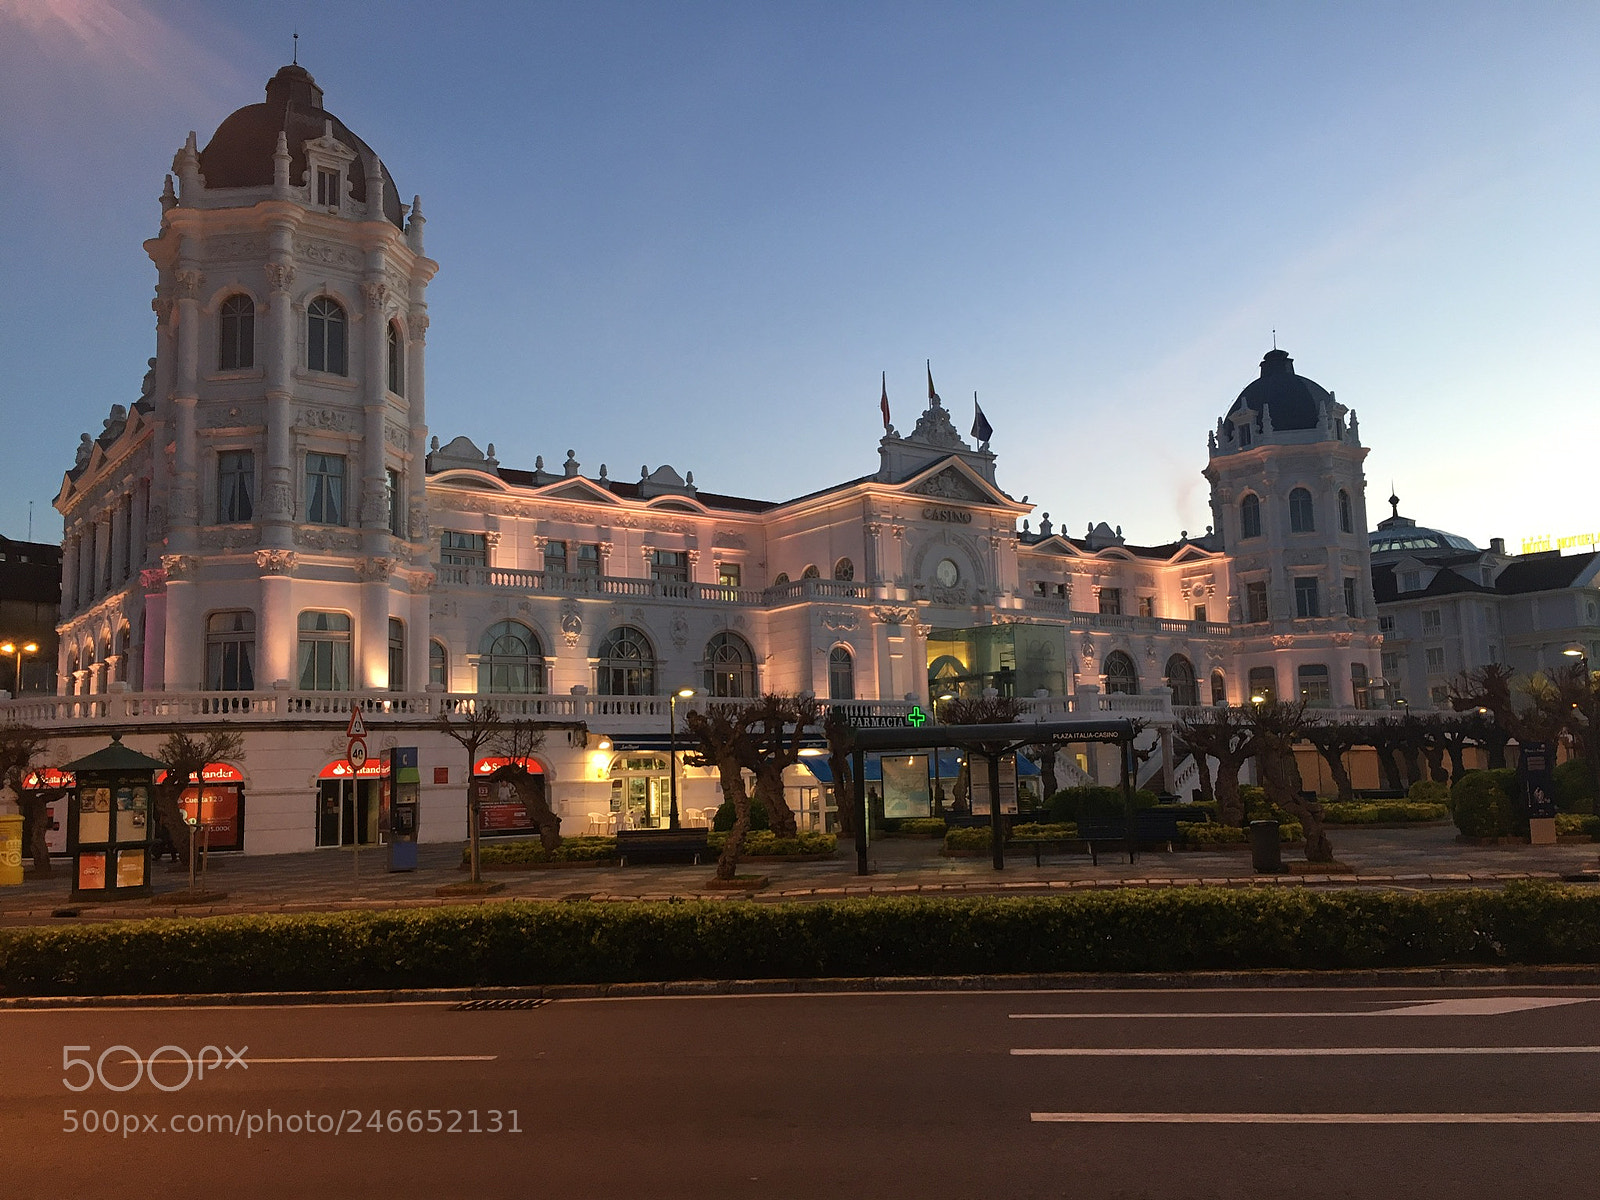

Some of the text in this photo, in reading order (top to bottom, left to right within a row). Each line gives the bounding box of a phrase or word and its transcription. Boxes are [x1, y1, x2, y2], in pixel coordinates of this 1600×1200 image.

[922, 508, 972, 525] CASINO
[850, 717, 905, 728] FARMACIA
[1074, 731, 1119, 739] ITALIA-CASINO
[352, 749, 364, 761] 40
